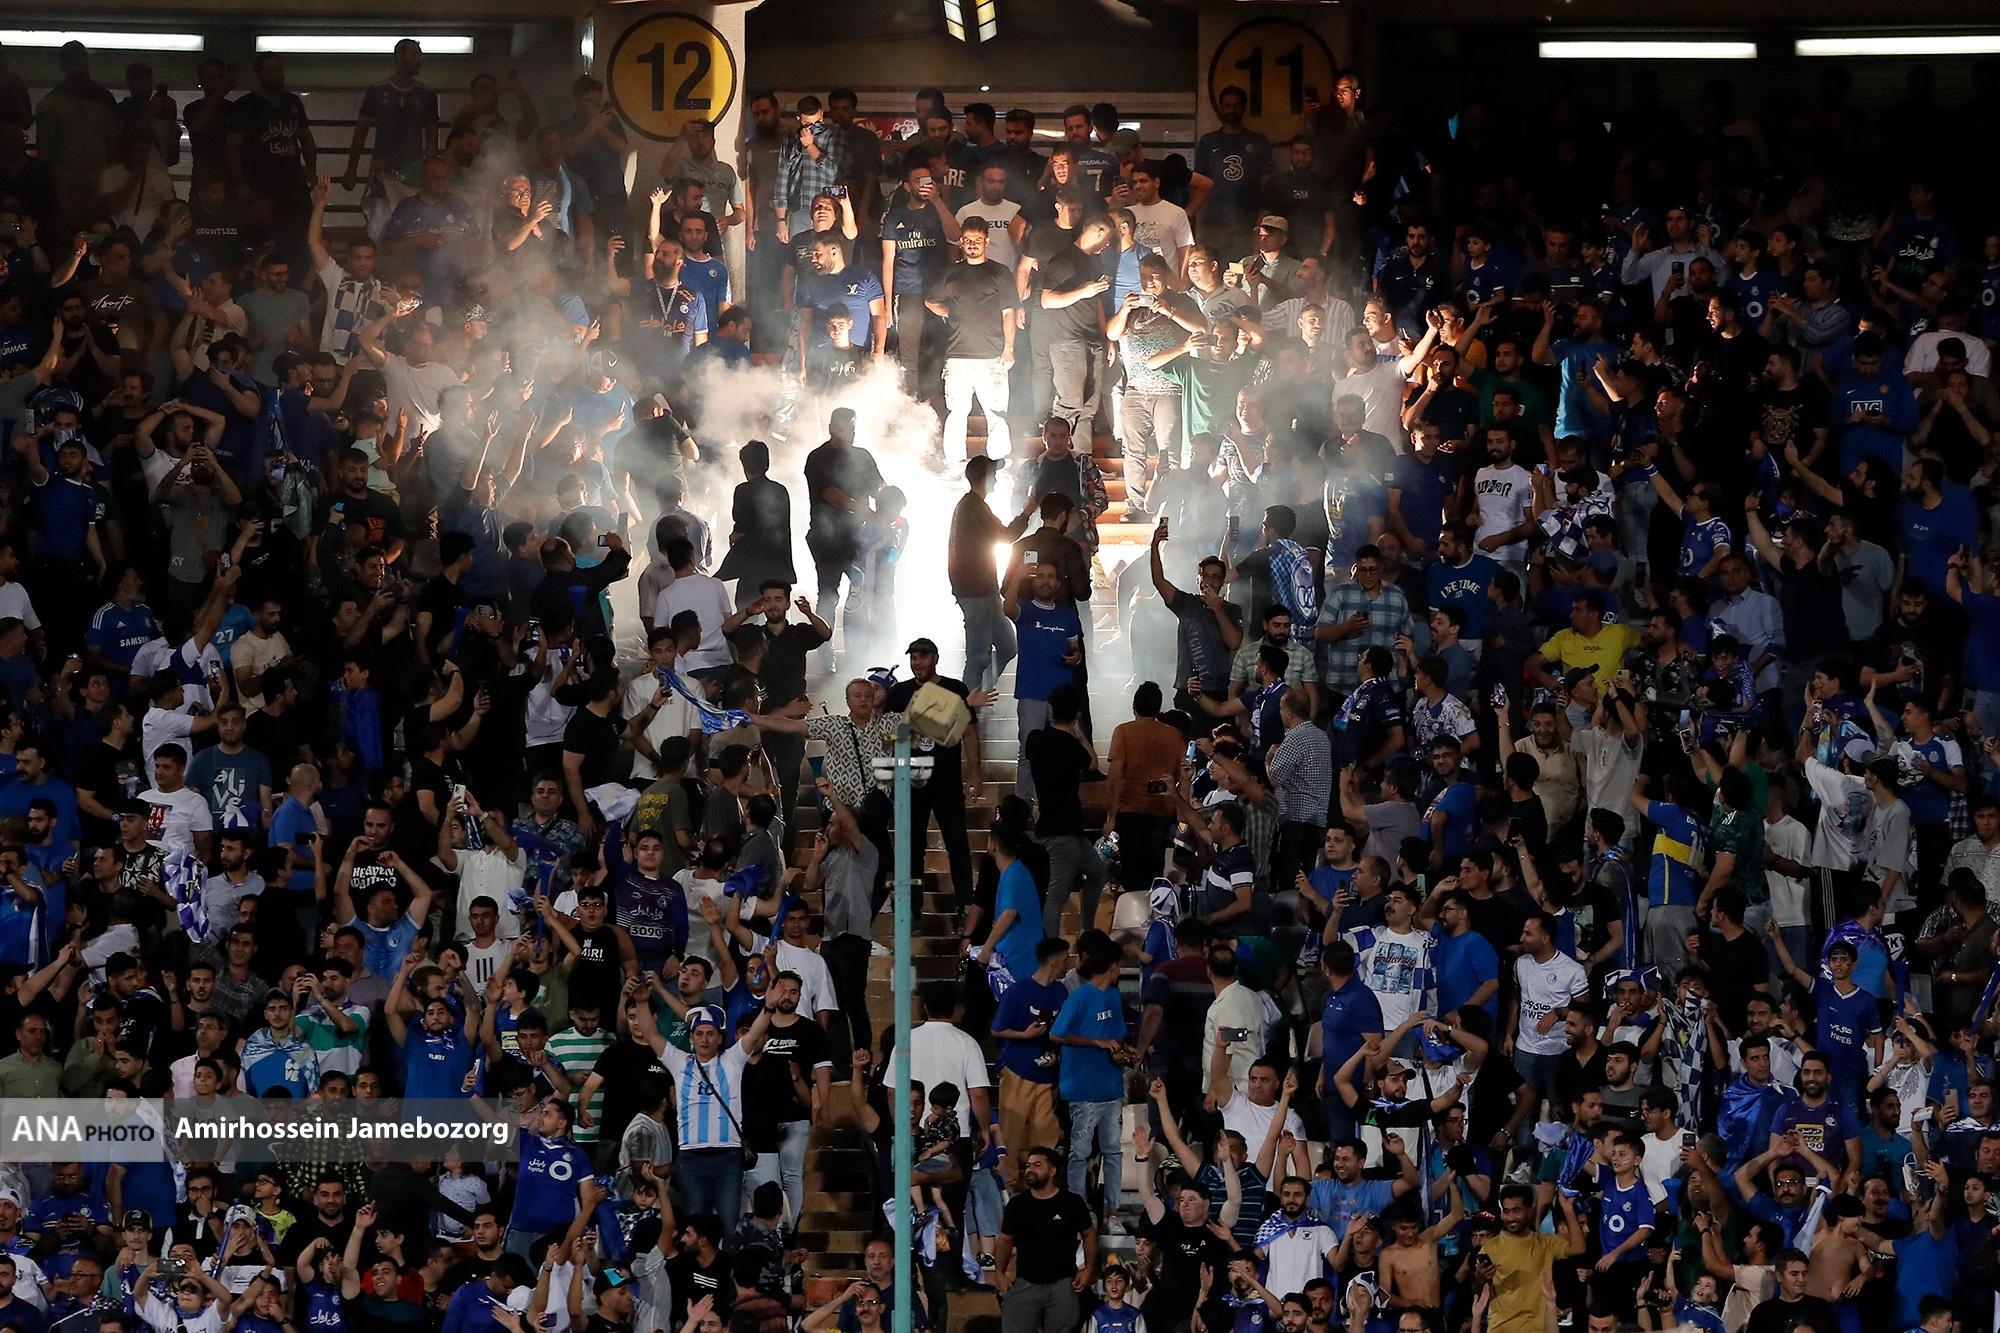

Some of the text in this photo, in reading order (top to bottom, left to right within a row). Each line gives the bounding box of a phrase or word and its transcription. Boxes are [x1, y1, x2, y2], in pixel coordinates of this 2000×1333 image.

[636, 42, 712, 111] 12
[1234, 46, 1301, 117] 11
[1087, 169, 1103, 192] 7
[987, 220, 1009, 228] EUS
[908, 231, 921, 240] Fly
[897, 238, 936, 250] Emirates
[1853, 402, 1881, 413] AIG
[1458, 579, 1481, 595] TIME
[215, 629, 234, 645] 27
[352, 866, 394, 878] HEAVEN
[631, 926, 663, 939] 3090
